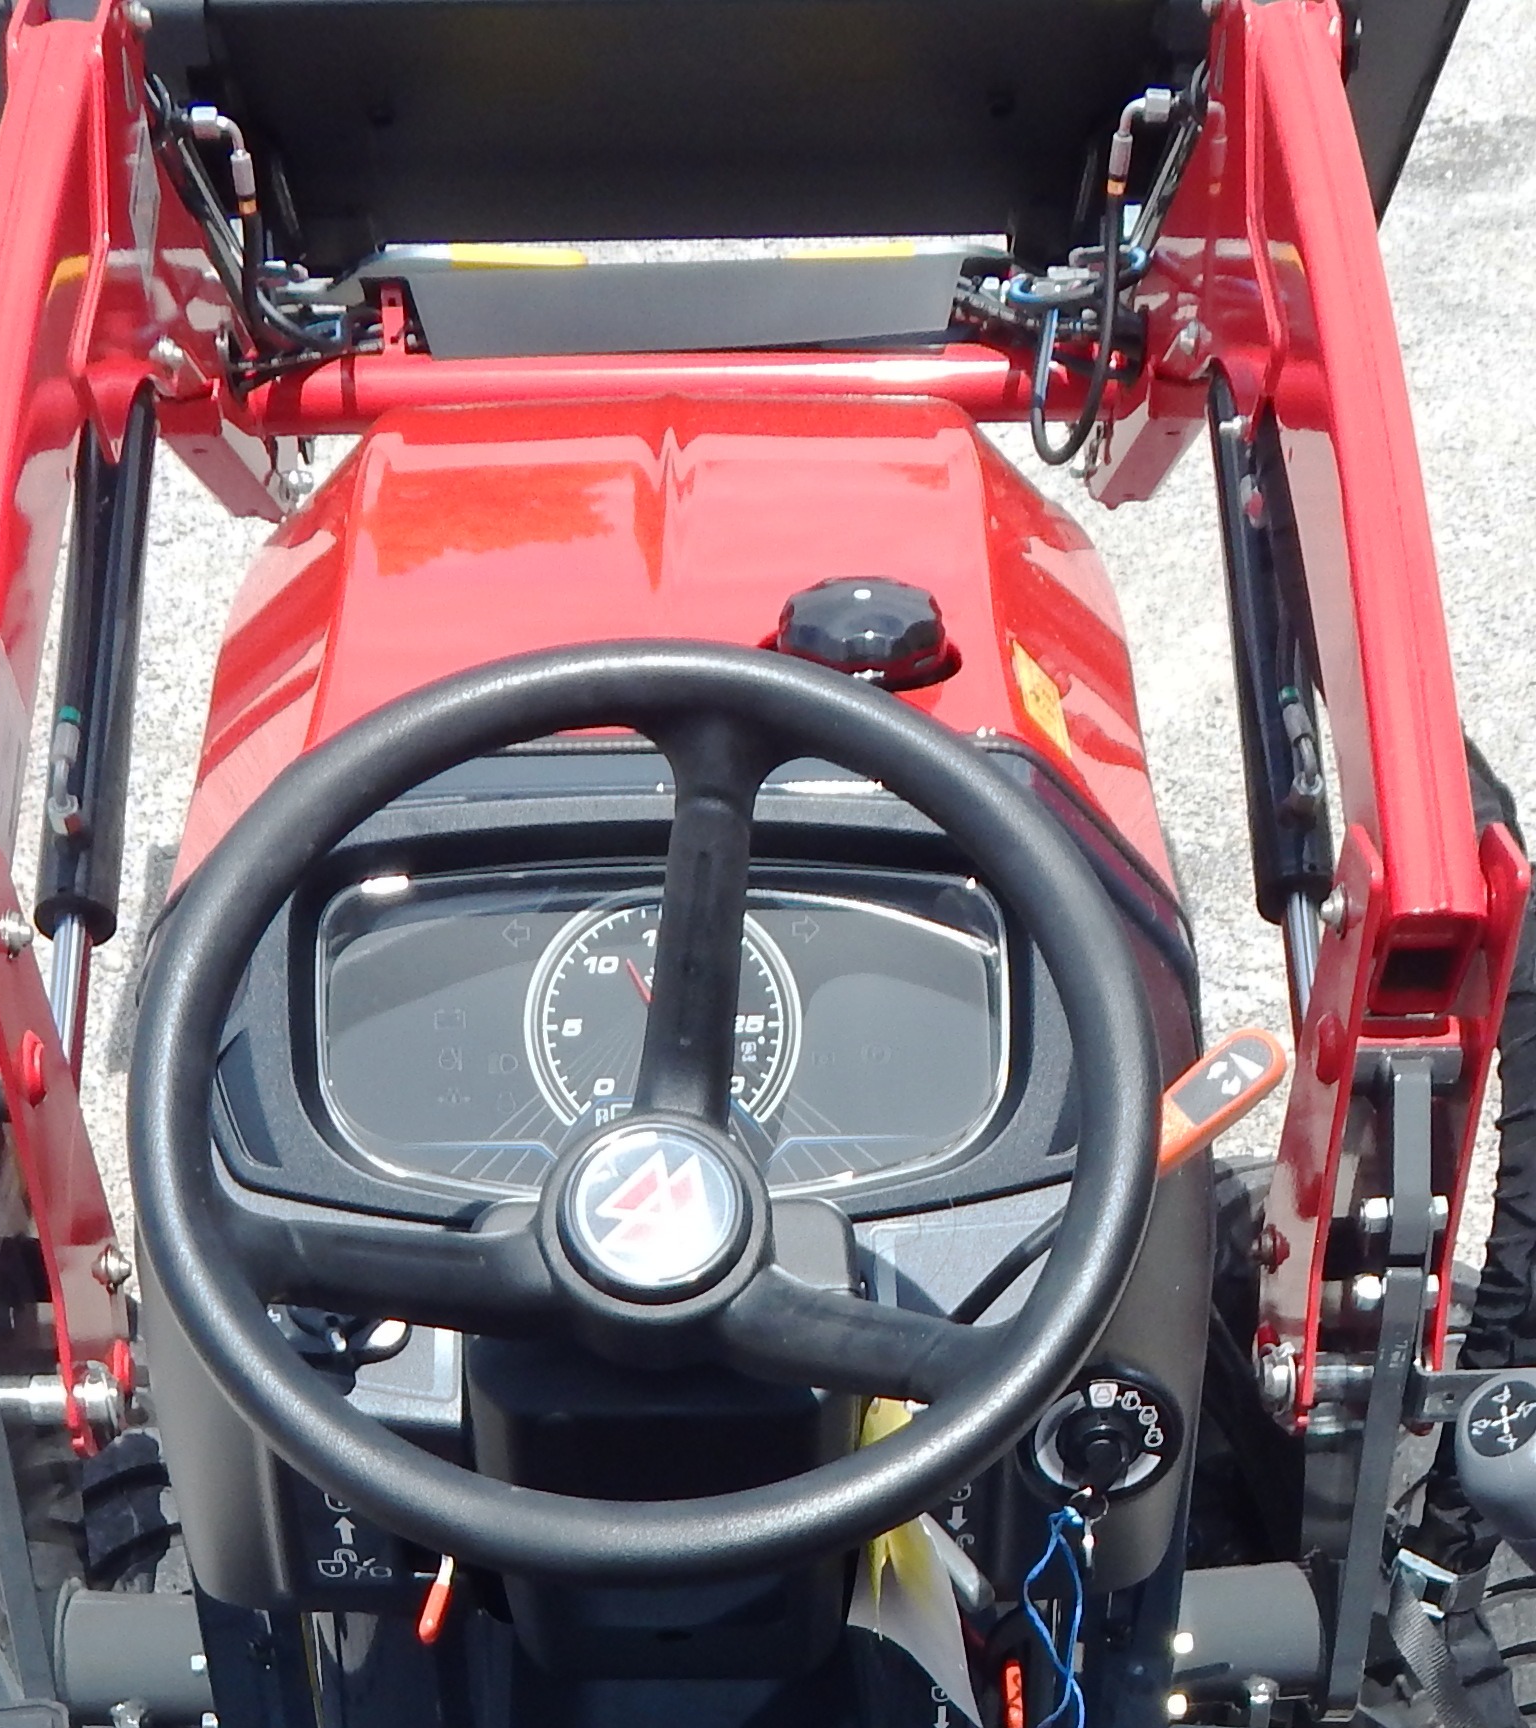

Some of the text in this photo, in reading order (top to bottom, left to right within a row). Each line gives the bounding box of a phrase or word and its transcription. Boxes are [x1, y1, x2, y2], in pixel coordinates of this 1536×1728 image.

[583, 956, 619, 974] 10
[561, 1018, 583, 1036] 5
[593, 1078, 615, 1096] 0
